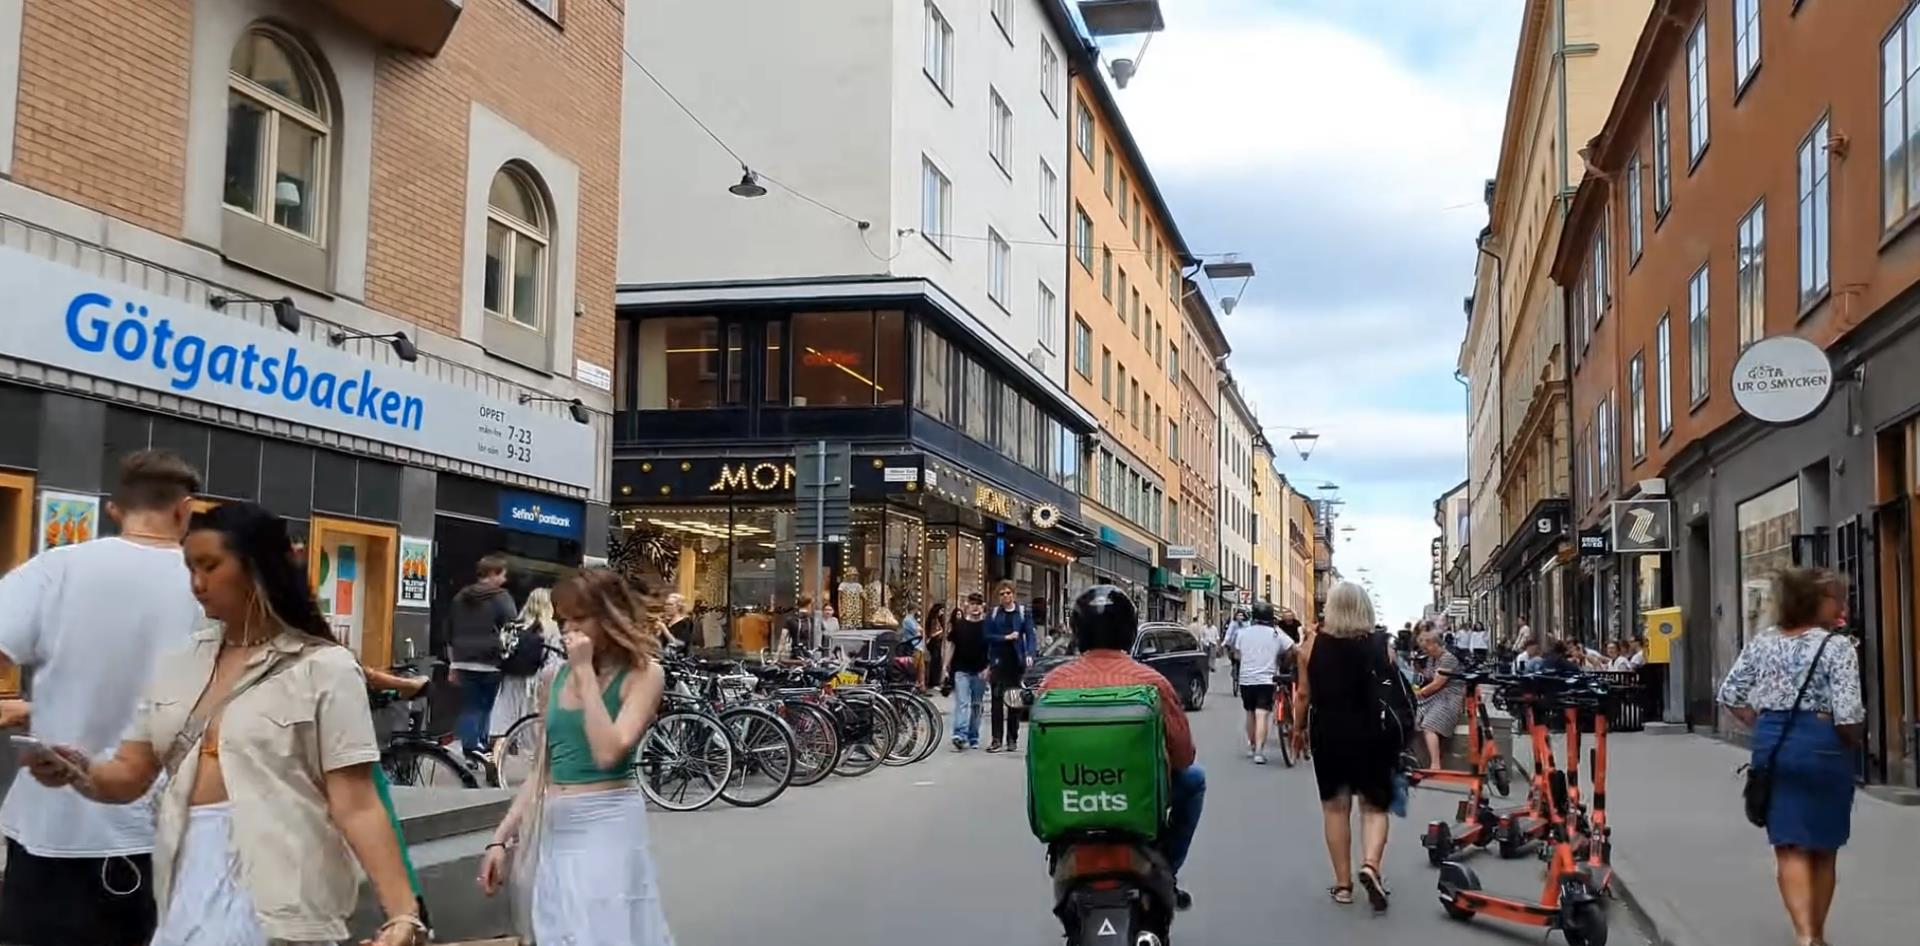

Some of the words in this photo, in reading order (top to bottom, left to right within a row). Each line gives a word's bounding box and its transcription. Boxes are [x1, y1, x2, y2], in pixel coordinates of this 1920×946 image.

[65, 292, 424, 431] Götgatsbacken
[1737, 381, 1754, 391] UR
[1770, 375, 1828, 390] SMYCKEN
[508, 425, 532, 445] 7-23
[507, 444, 532, 463] 9-23
[512, 507, 534, 521] Sefina
[1060, 763, 1126, 786] Uber
[1061, 790, 1128, 813] Eats
